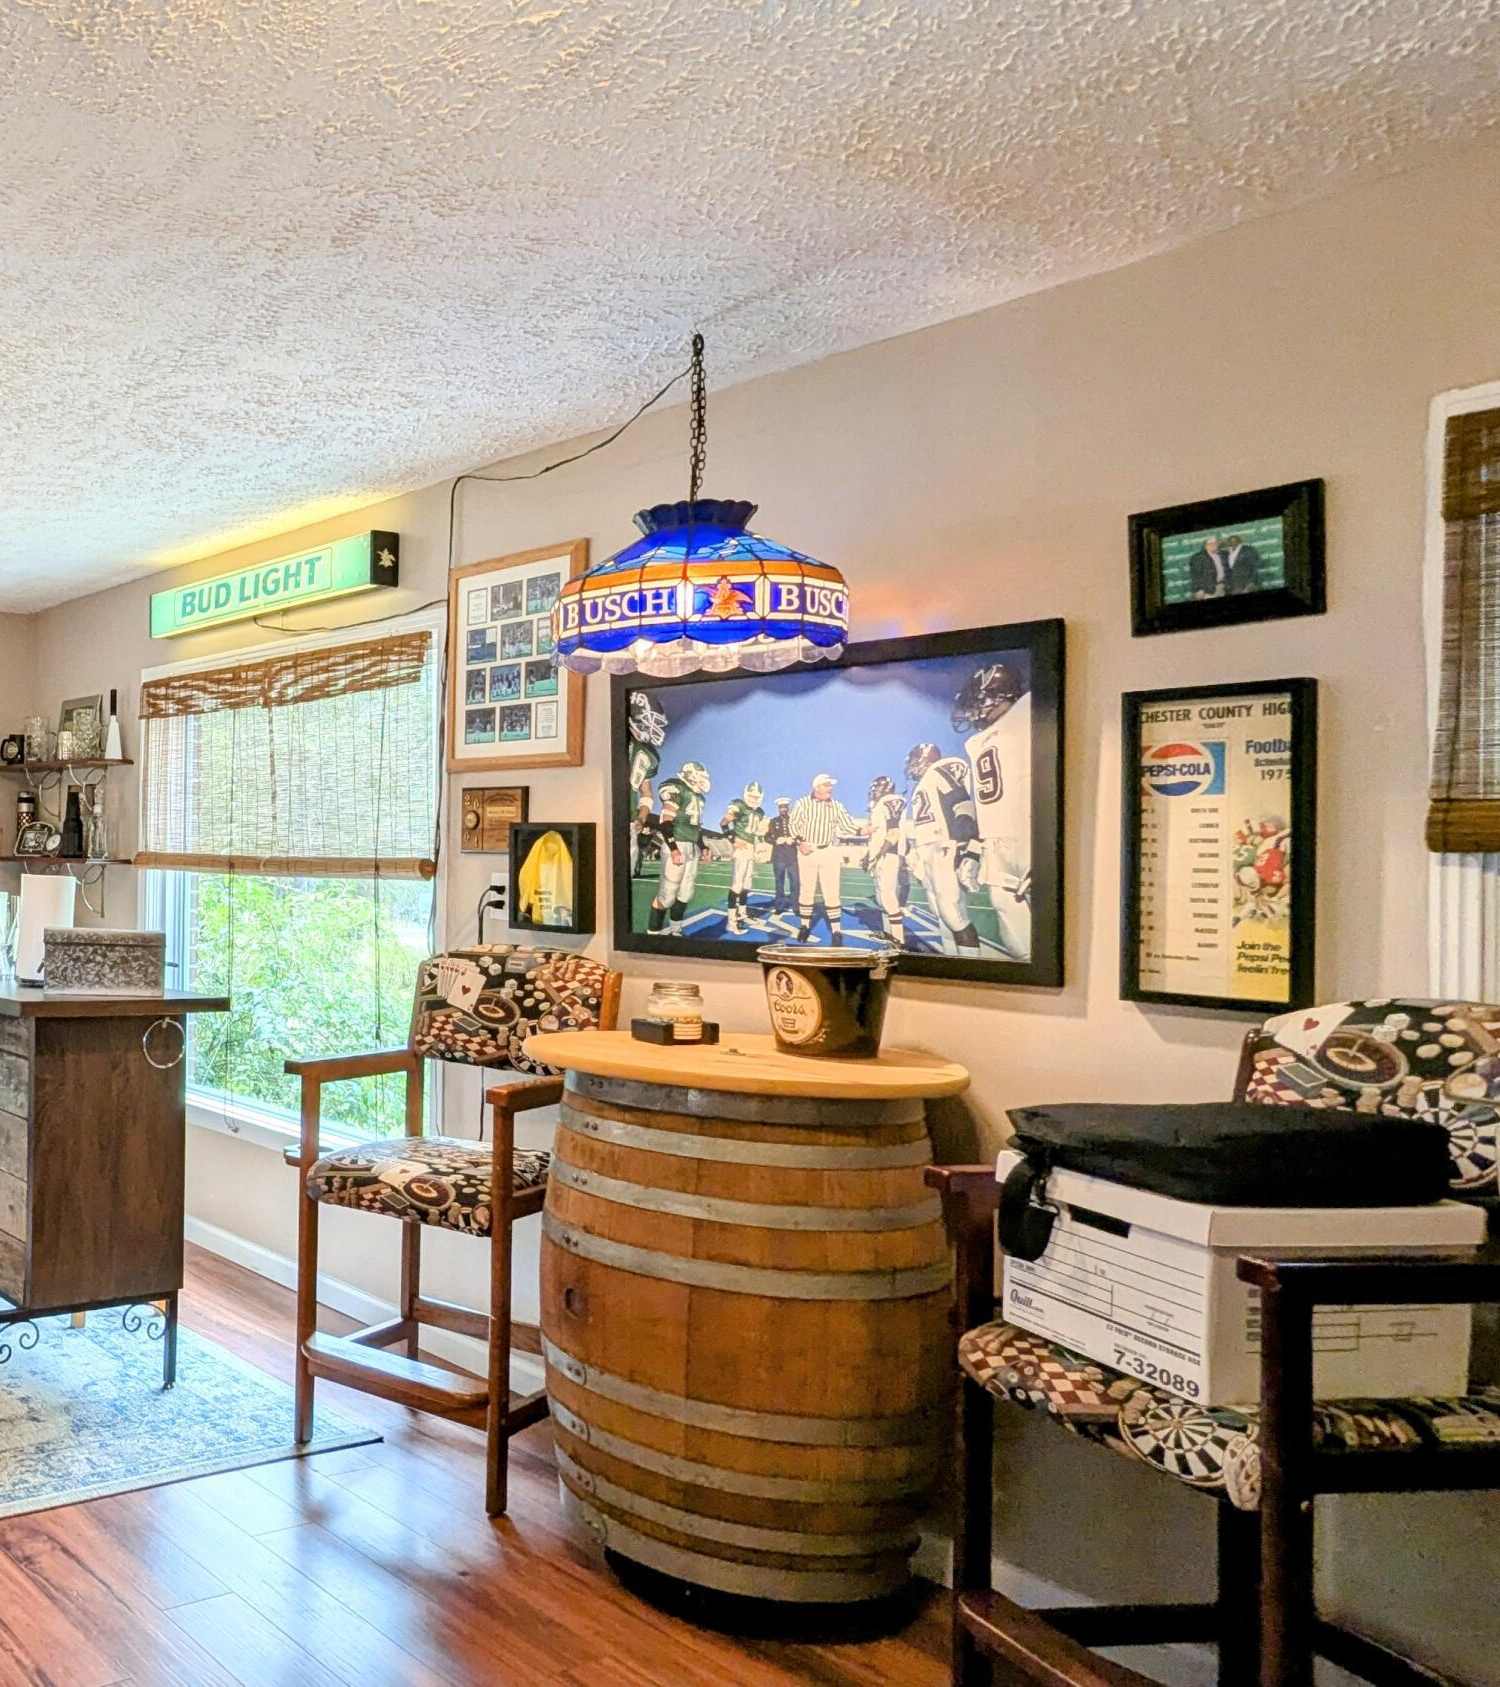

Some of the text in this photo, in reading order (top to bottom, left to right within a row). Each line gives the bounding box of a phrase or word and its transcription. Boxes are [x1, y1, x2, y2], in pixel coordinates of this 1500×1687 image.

[180, 556, 323, 618] BUD LIGHT
[777, 583, 847, 618] BUSC
[565, 587, 672, 630] BUSCH
[1198, 704, 1254, 720] COUNTY
[1140, 762, 1212, 778] PEPSI-COLA
[1113, 1348, 1200, 1398] 7-32089
